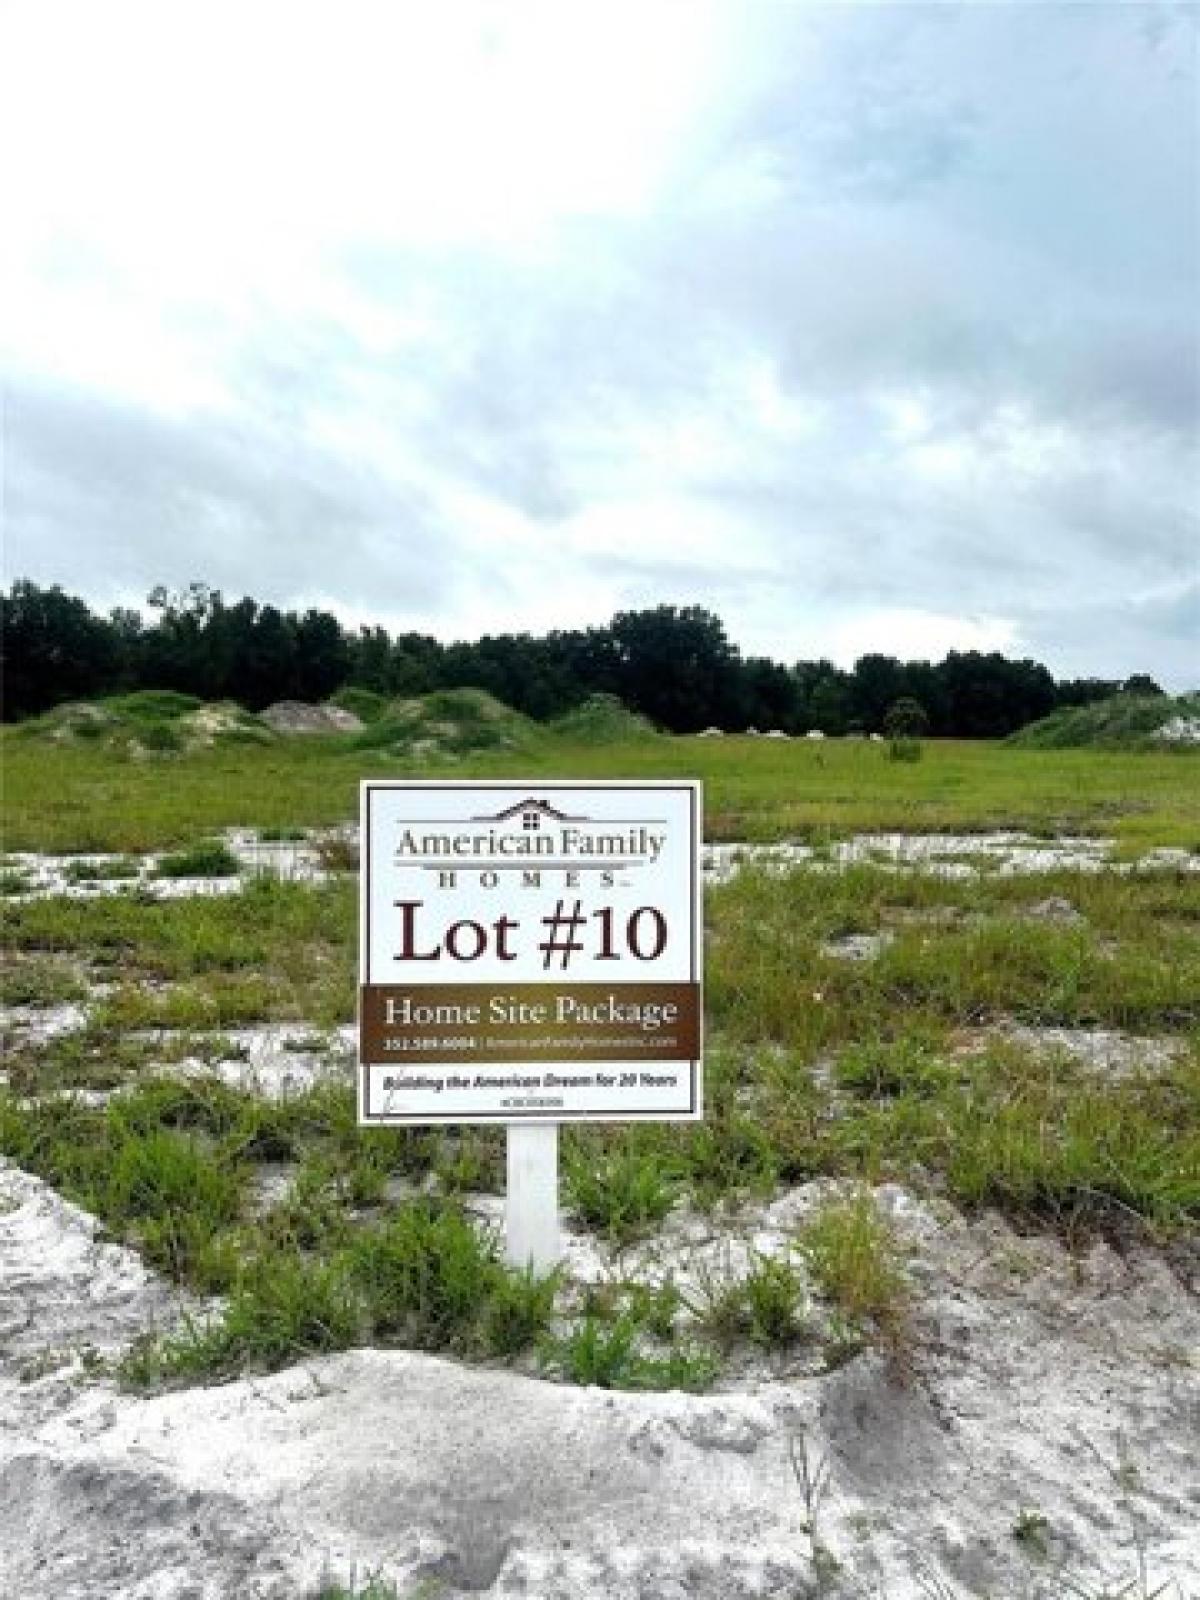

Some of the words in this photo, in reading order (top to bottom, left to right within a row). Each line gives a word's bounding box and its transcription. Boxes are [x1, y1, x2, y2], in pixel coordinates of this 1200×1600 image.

[397, 829, 553, 855] American
[560, 828, 667, 863] Family
[393, 900, 520, 961] Lot
[539, 900, 668, 970] #10
[385, 996, 480, 1025] Home
[489, 995, 547, 1025] Site
[555, 993, 678, 1030] Package
[383, 1074, 444, 1093] Building
[446, 1073, 471, 1088] the
[473, 1073, 540, 1088] American
[543, 1073, 594, 1088] Dream
[595, 1073, 617, 1087] for
[619, 1072, 637, 1088] 20
[639, 1072, 678, 1087] Years
